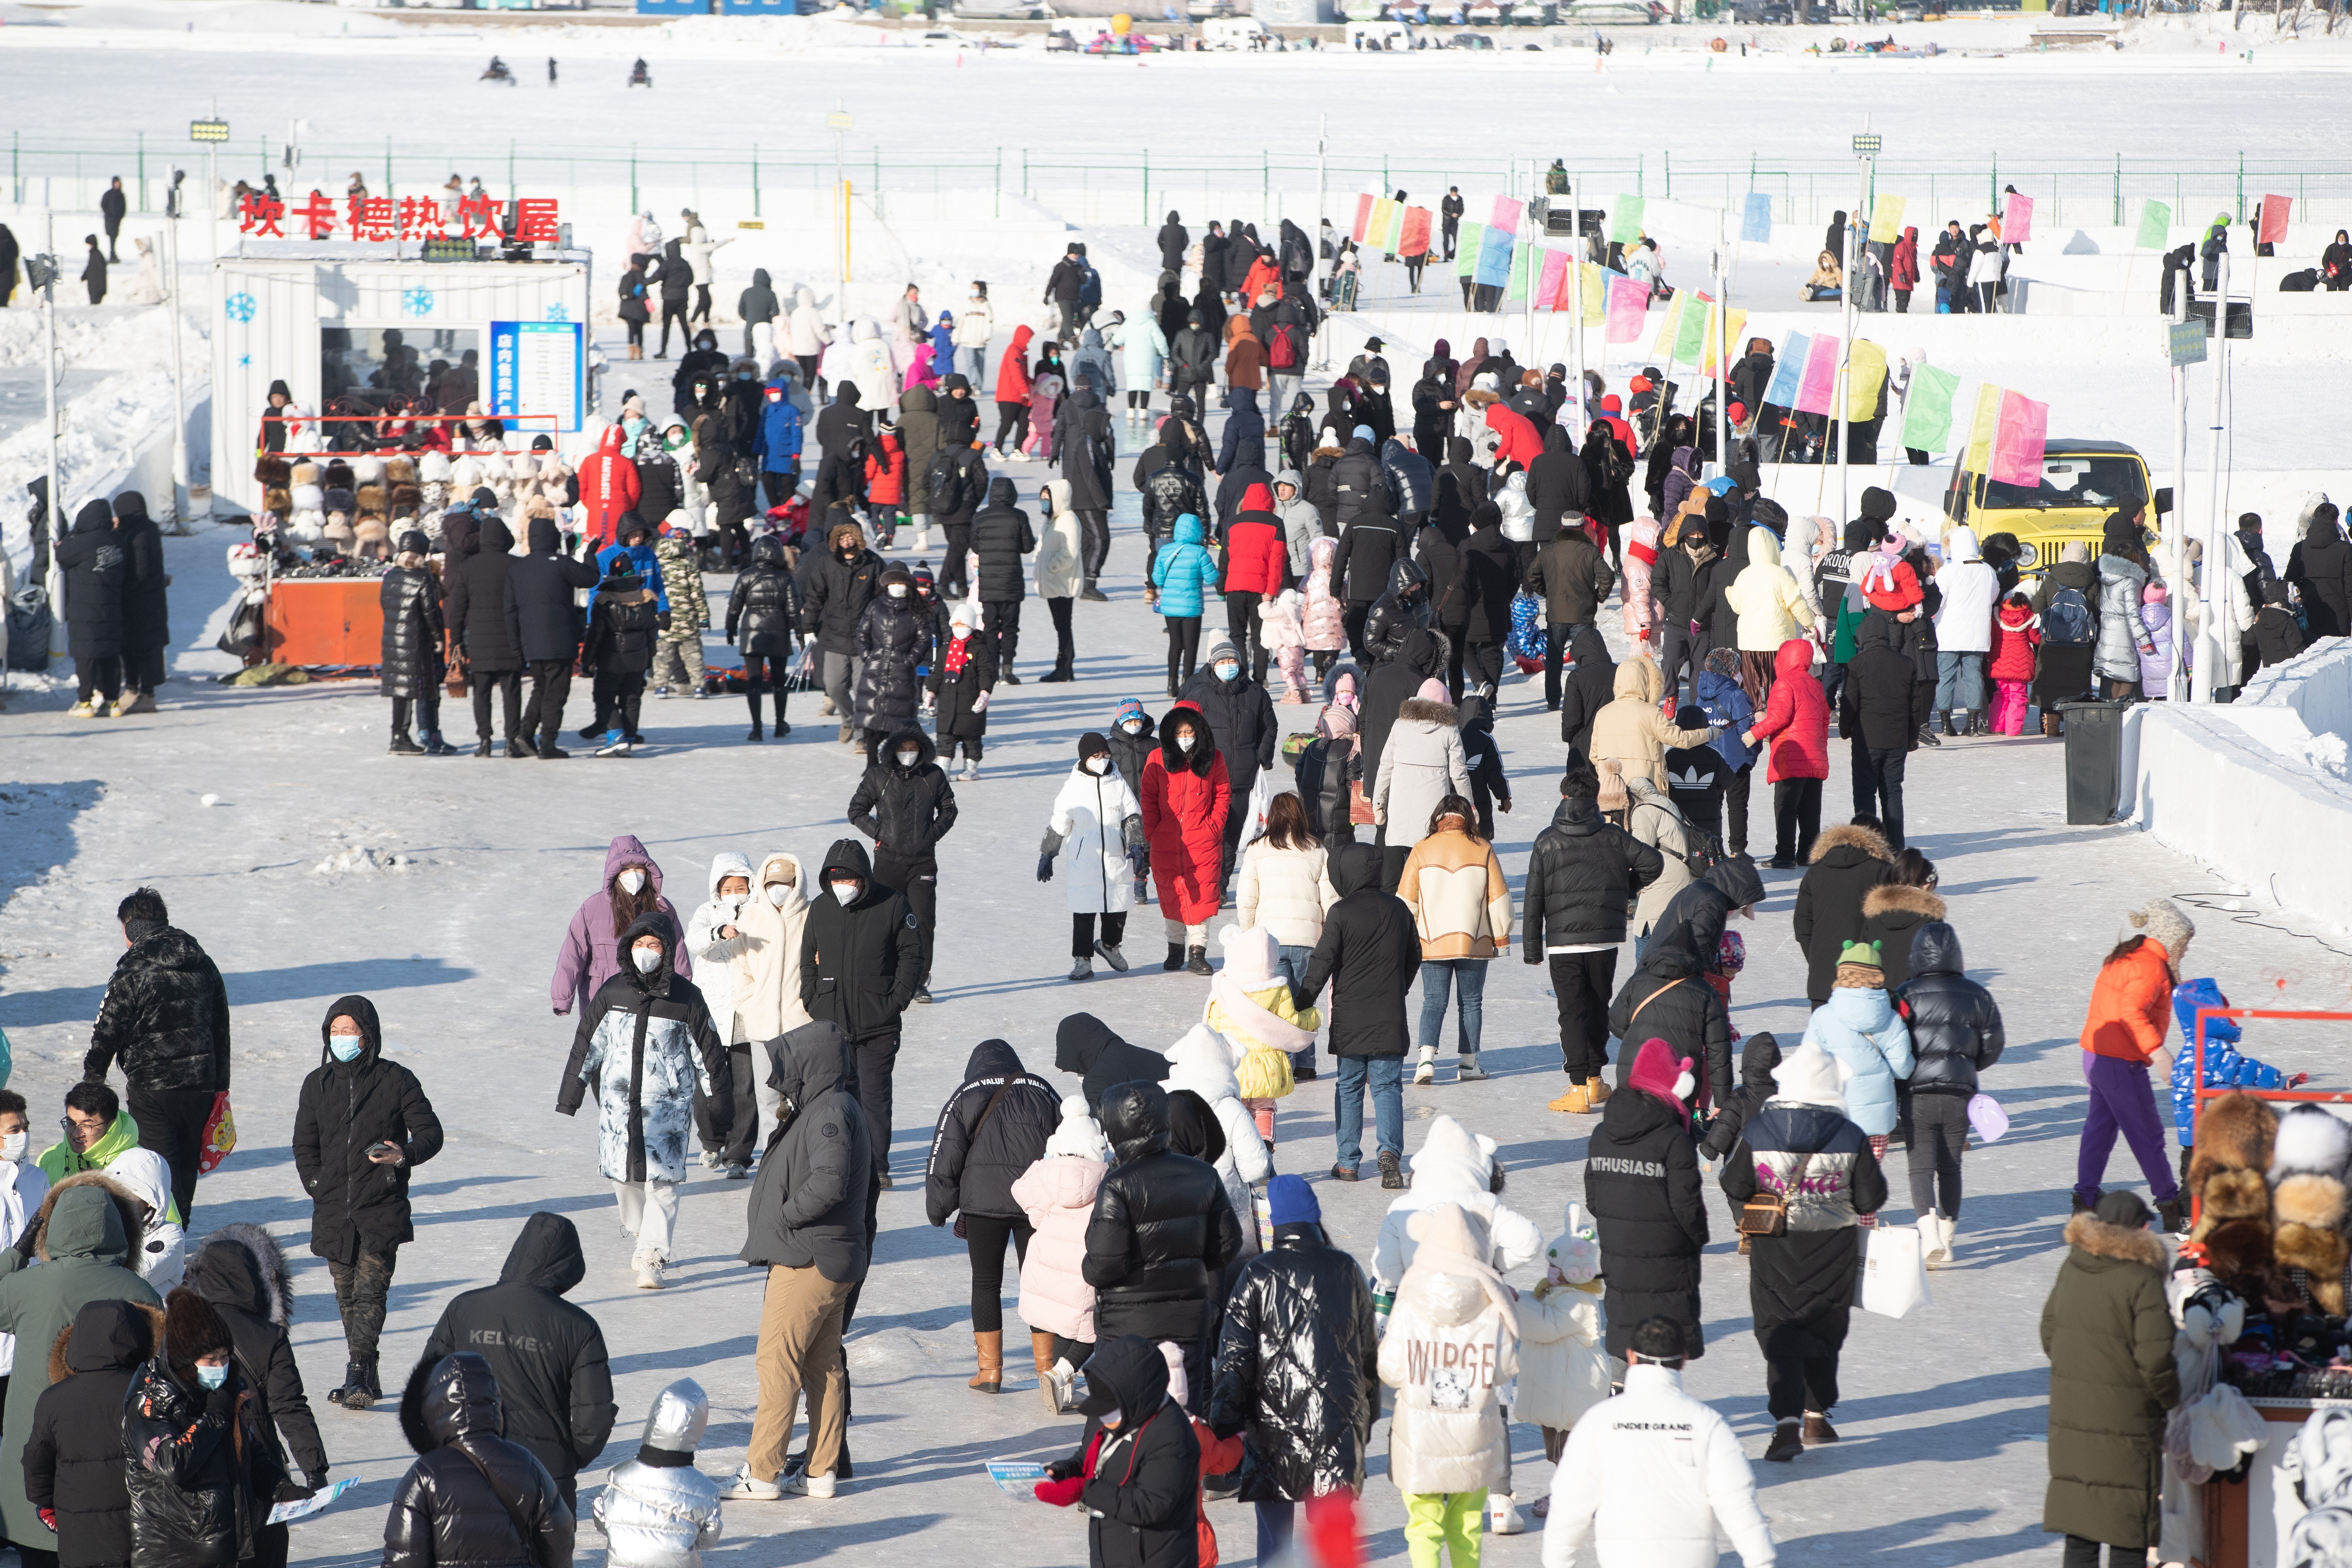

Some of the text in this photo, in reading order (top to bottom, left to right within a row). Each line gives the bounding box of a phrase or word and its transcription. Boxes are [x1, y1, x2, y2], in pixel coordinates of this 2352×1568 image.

[239, 192, 560, 242] 坎卡德热饮屋
[1028, 1079, 1048, 1092] VALUE
[932, 1132, 943, 1155] VALUE
[469, 1329, 538, 1353] KELME
[1612, 1422, 1649, 1430] UNDER
